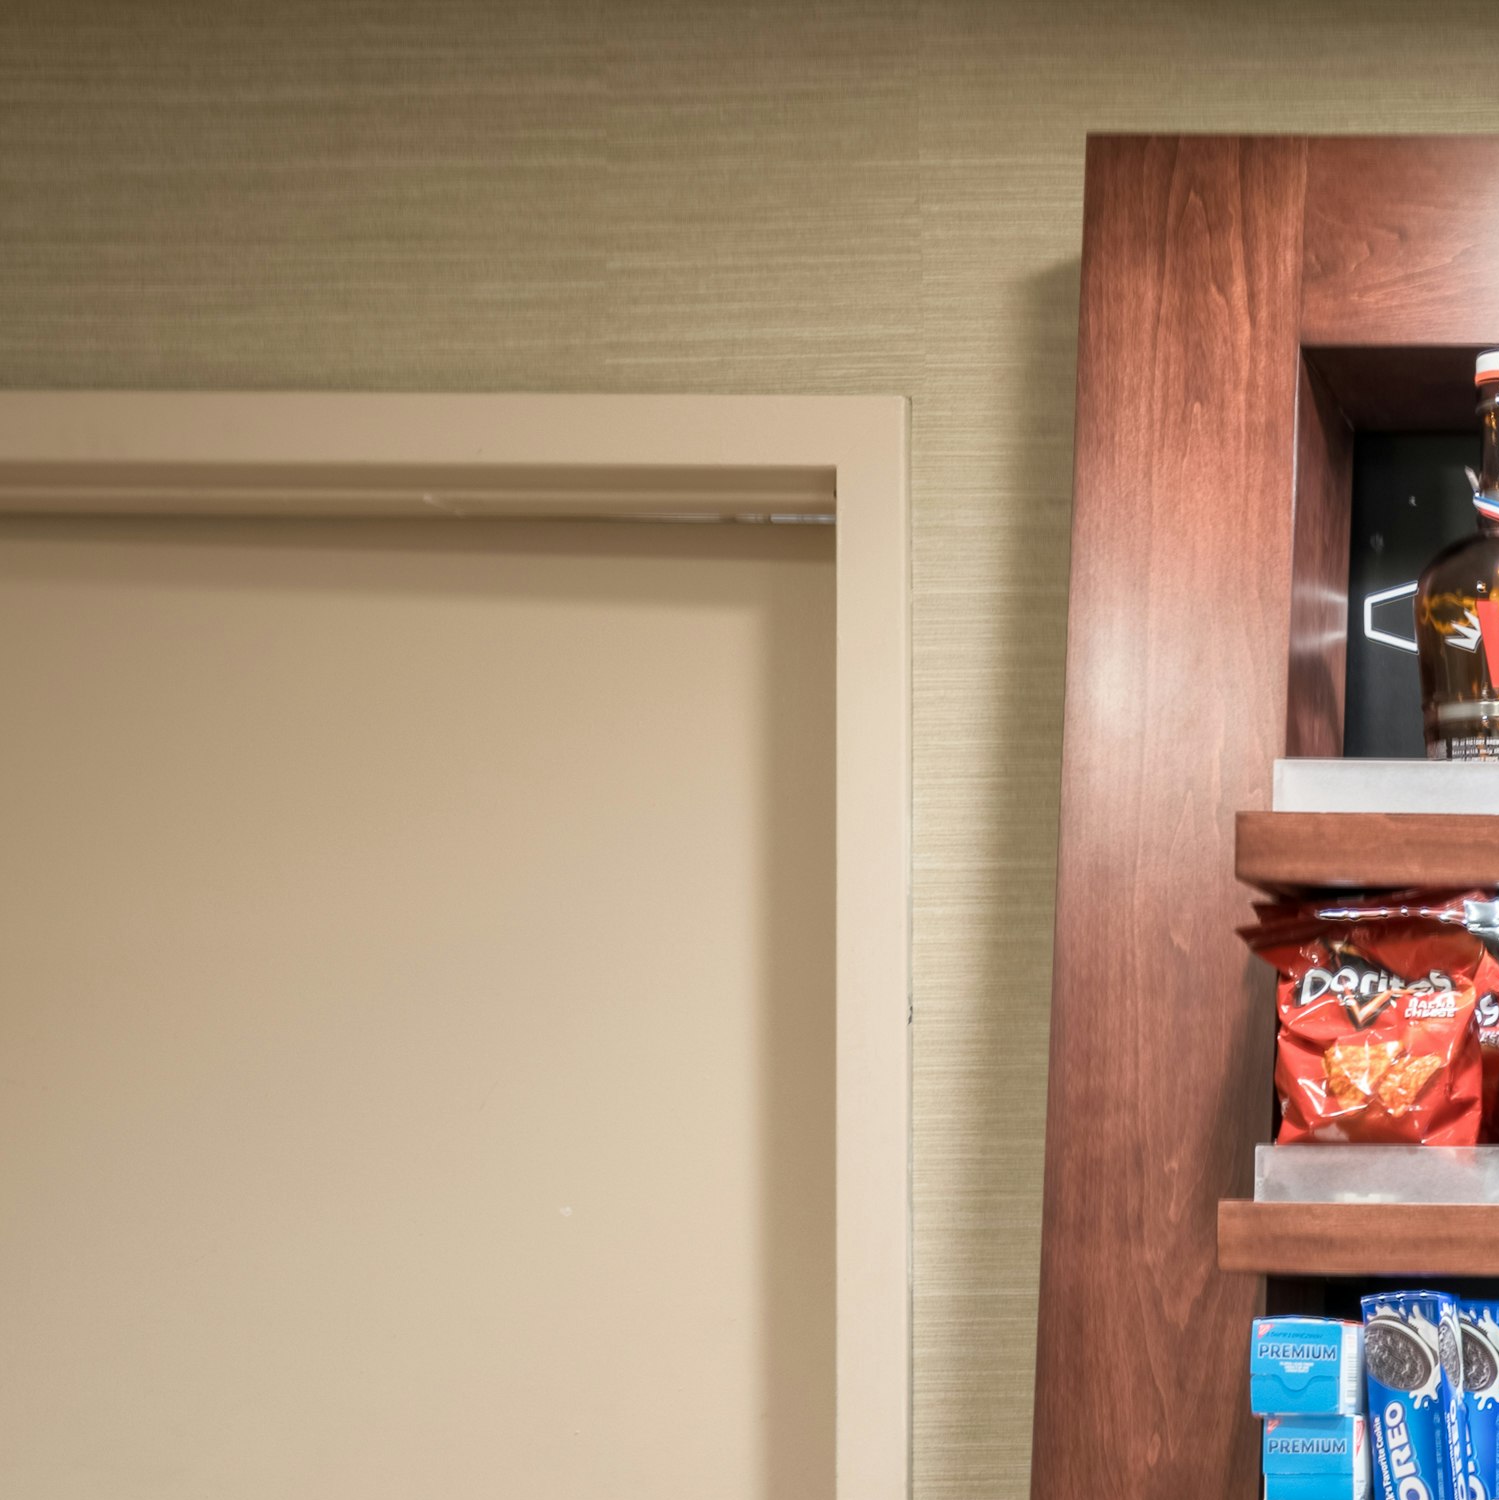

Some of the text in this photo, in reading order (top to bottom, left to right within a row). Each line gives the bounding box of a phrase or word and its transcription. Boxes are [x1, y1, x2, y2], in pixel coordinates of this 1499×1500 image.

[1299, 966, 1454, 1007] Doritos
[1257, 1343, 1338, 1361] PREMIUM
[1268, 1438, 1348, 1455] PREMIUM
[1373, 1416, 1383, 1448] Cookie
[1378, 1449, 1391, 1485] Favorite
